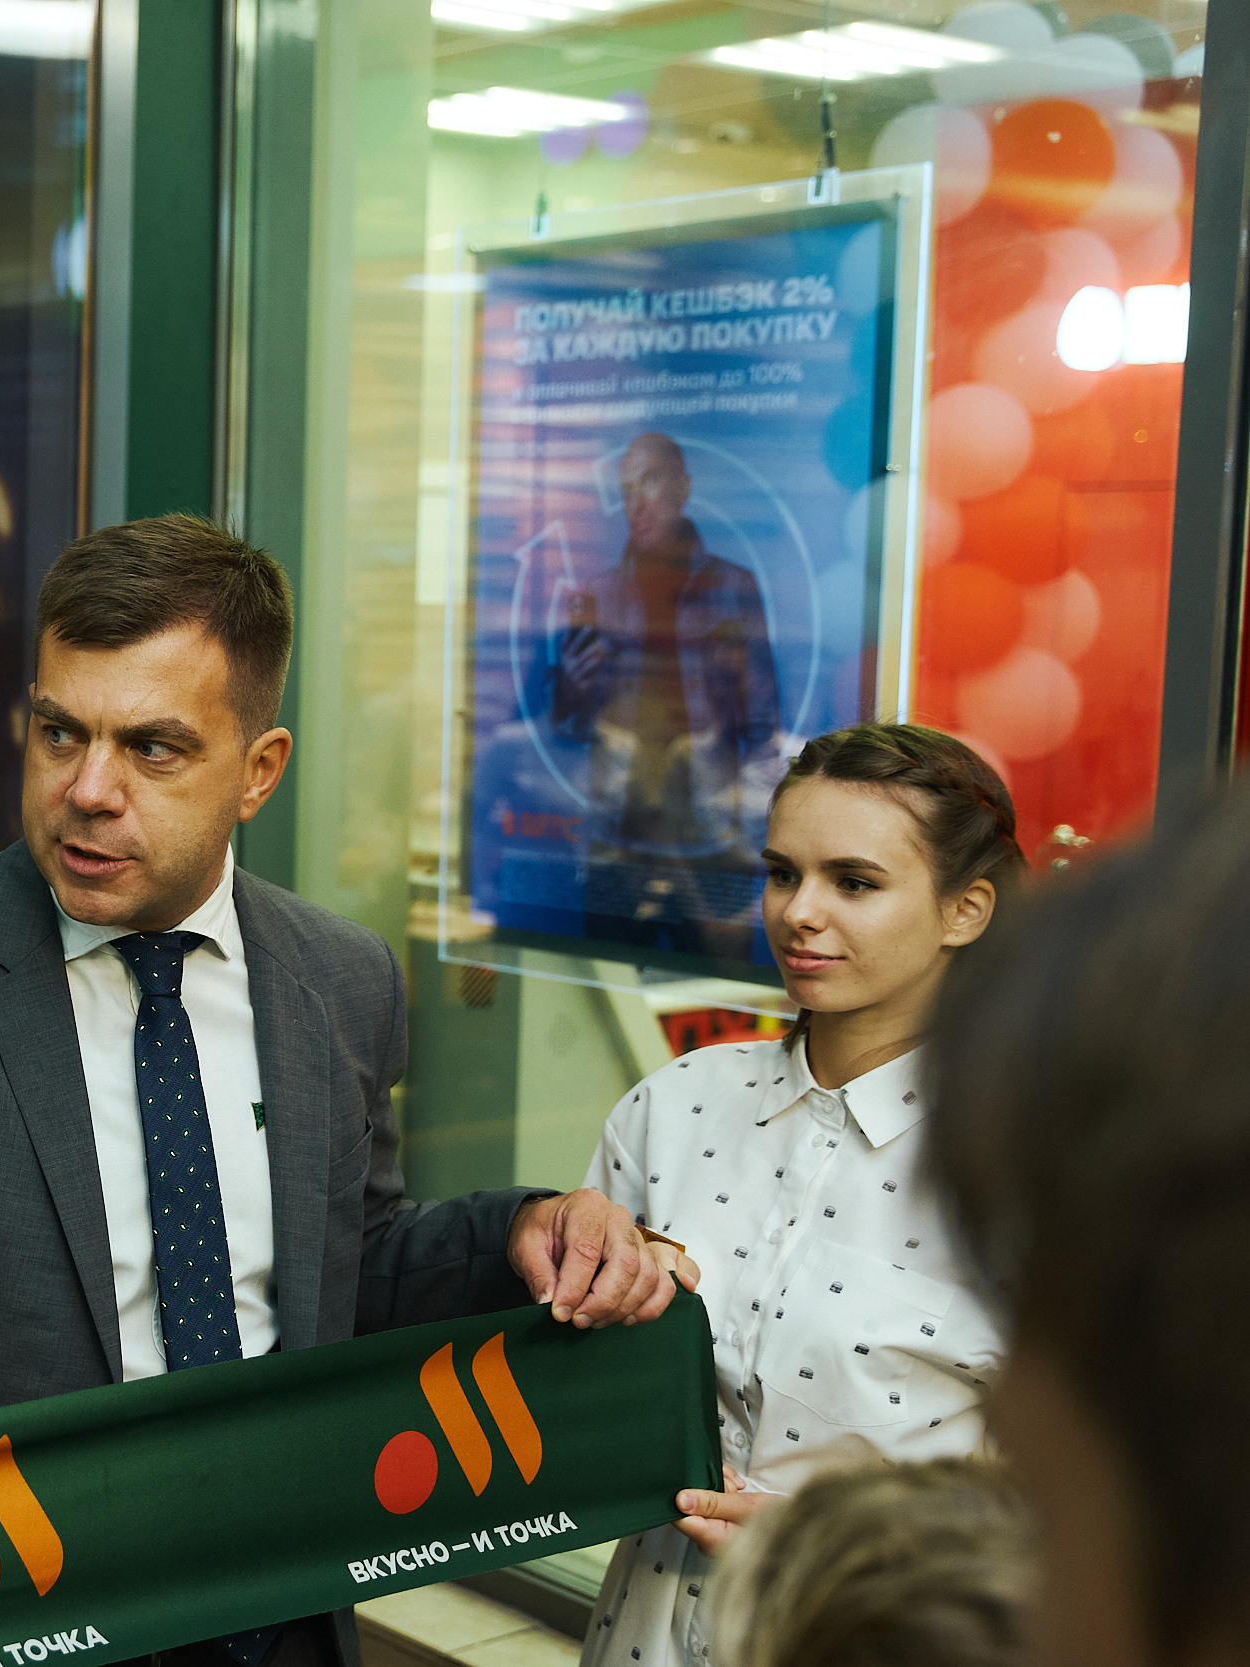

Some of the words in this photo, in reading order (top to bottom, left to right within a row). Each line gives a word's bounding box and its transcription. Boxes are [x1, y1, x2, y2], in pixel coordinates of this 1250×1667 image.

[513, 288, 645, 332] ПОЛУЧАЙ
[650, 281, 777, 318] КЕШБЭК
[782, 274, 835, 307] 2%
[513, 337, 549, 366] ЗА
[552, 324, 686, 362] КАЖДУЮ
[691, 310, 838, 350] ПОКУПКУ
[748, 361, 805, 385] 100%
[347, 1541, 450, 1584] ВКУСНО
[471, 1530, 495, 1553] И
[493, 1511, 578, 1547] ТОЧКА
[2, 1625, 110, 1665] ТОЧКА
